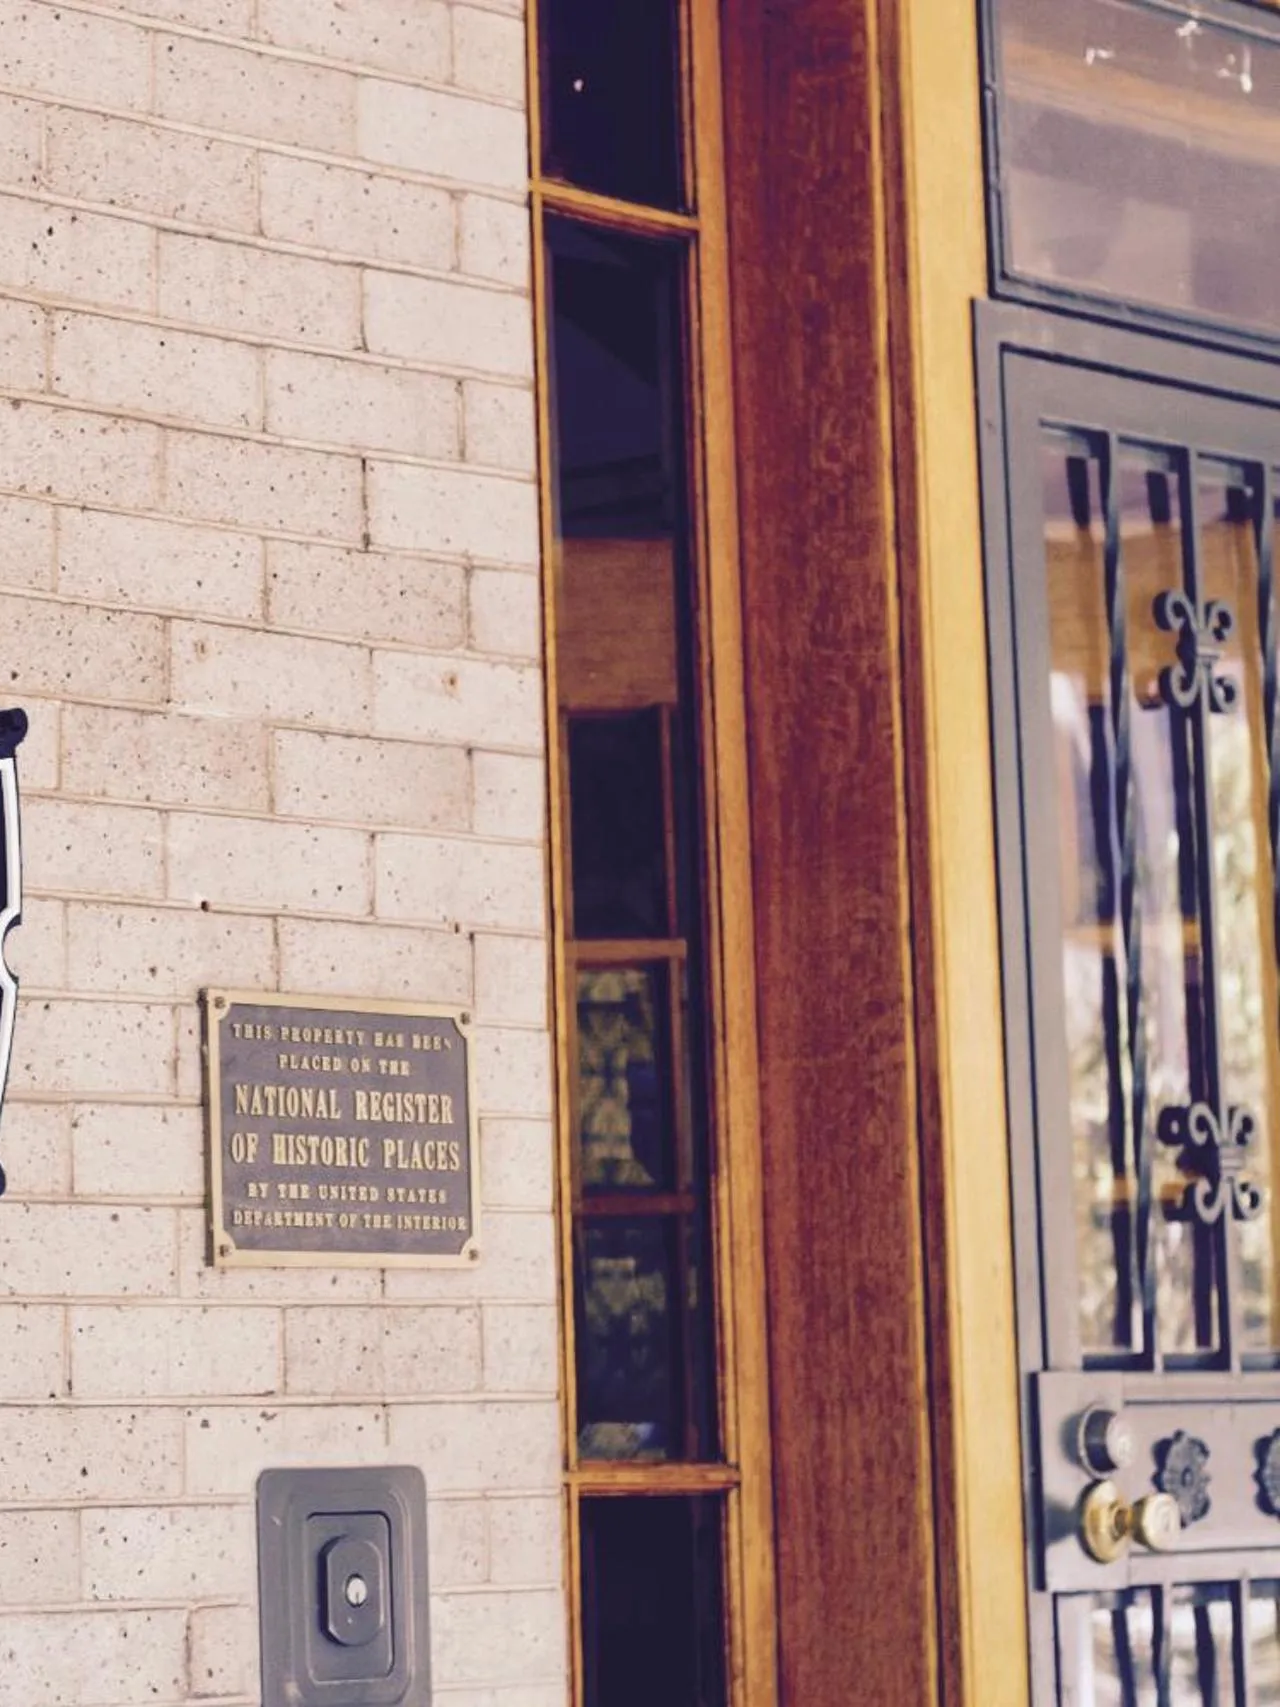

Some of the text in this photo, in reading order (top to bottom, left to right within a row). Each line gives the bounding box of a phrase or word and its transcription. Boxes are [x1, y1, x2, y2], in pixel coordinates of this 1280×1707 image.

[232, 1023, 271, 1040] THIS
[280, 1027, 365, 1046] PROPERTY
[373, 1032, 404, 1049] HAS
[278, 1054, 410, 1077] PLACED ON THE
[235, 1084, 454, 1124] NATIONAL REGISTER
[231, 1132, 460, 1171] OF HISTORIC PLACES
[248, 1182, 447, 1205] BY THE UNITED STATES
[233, 1210, 467, 1232] DEPARTMENT OF THE INTERIOR
